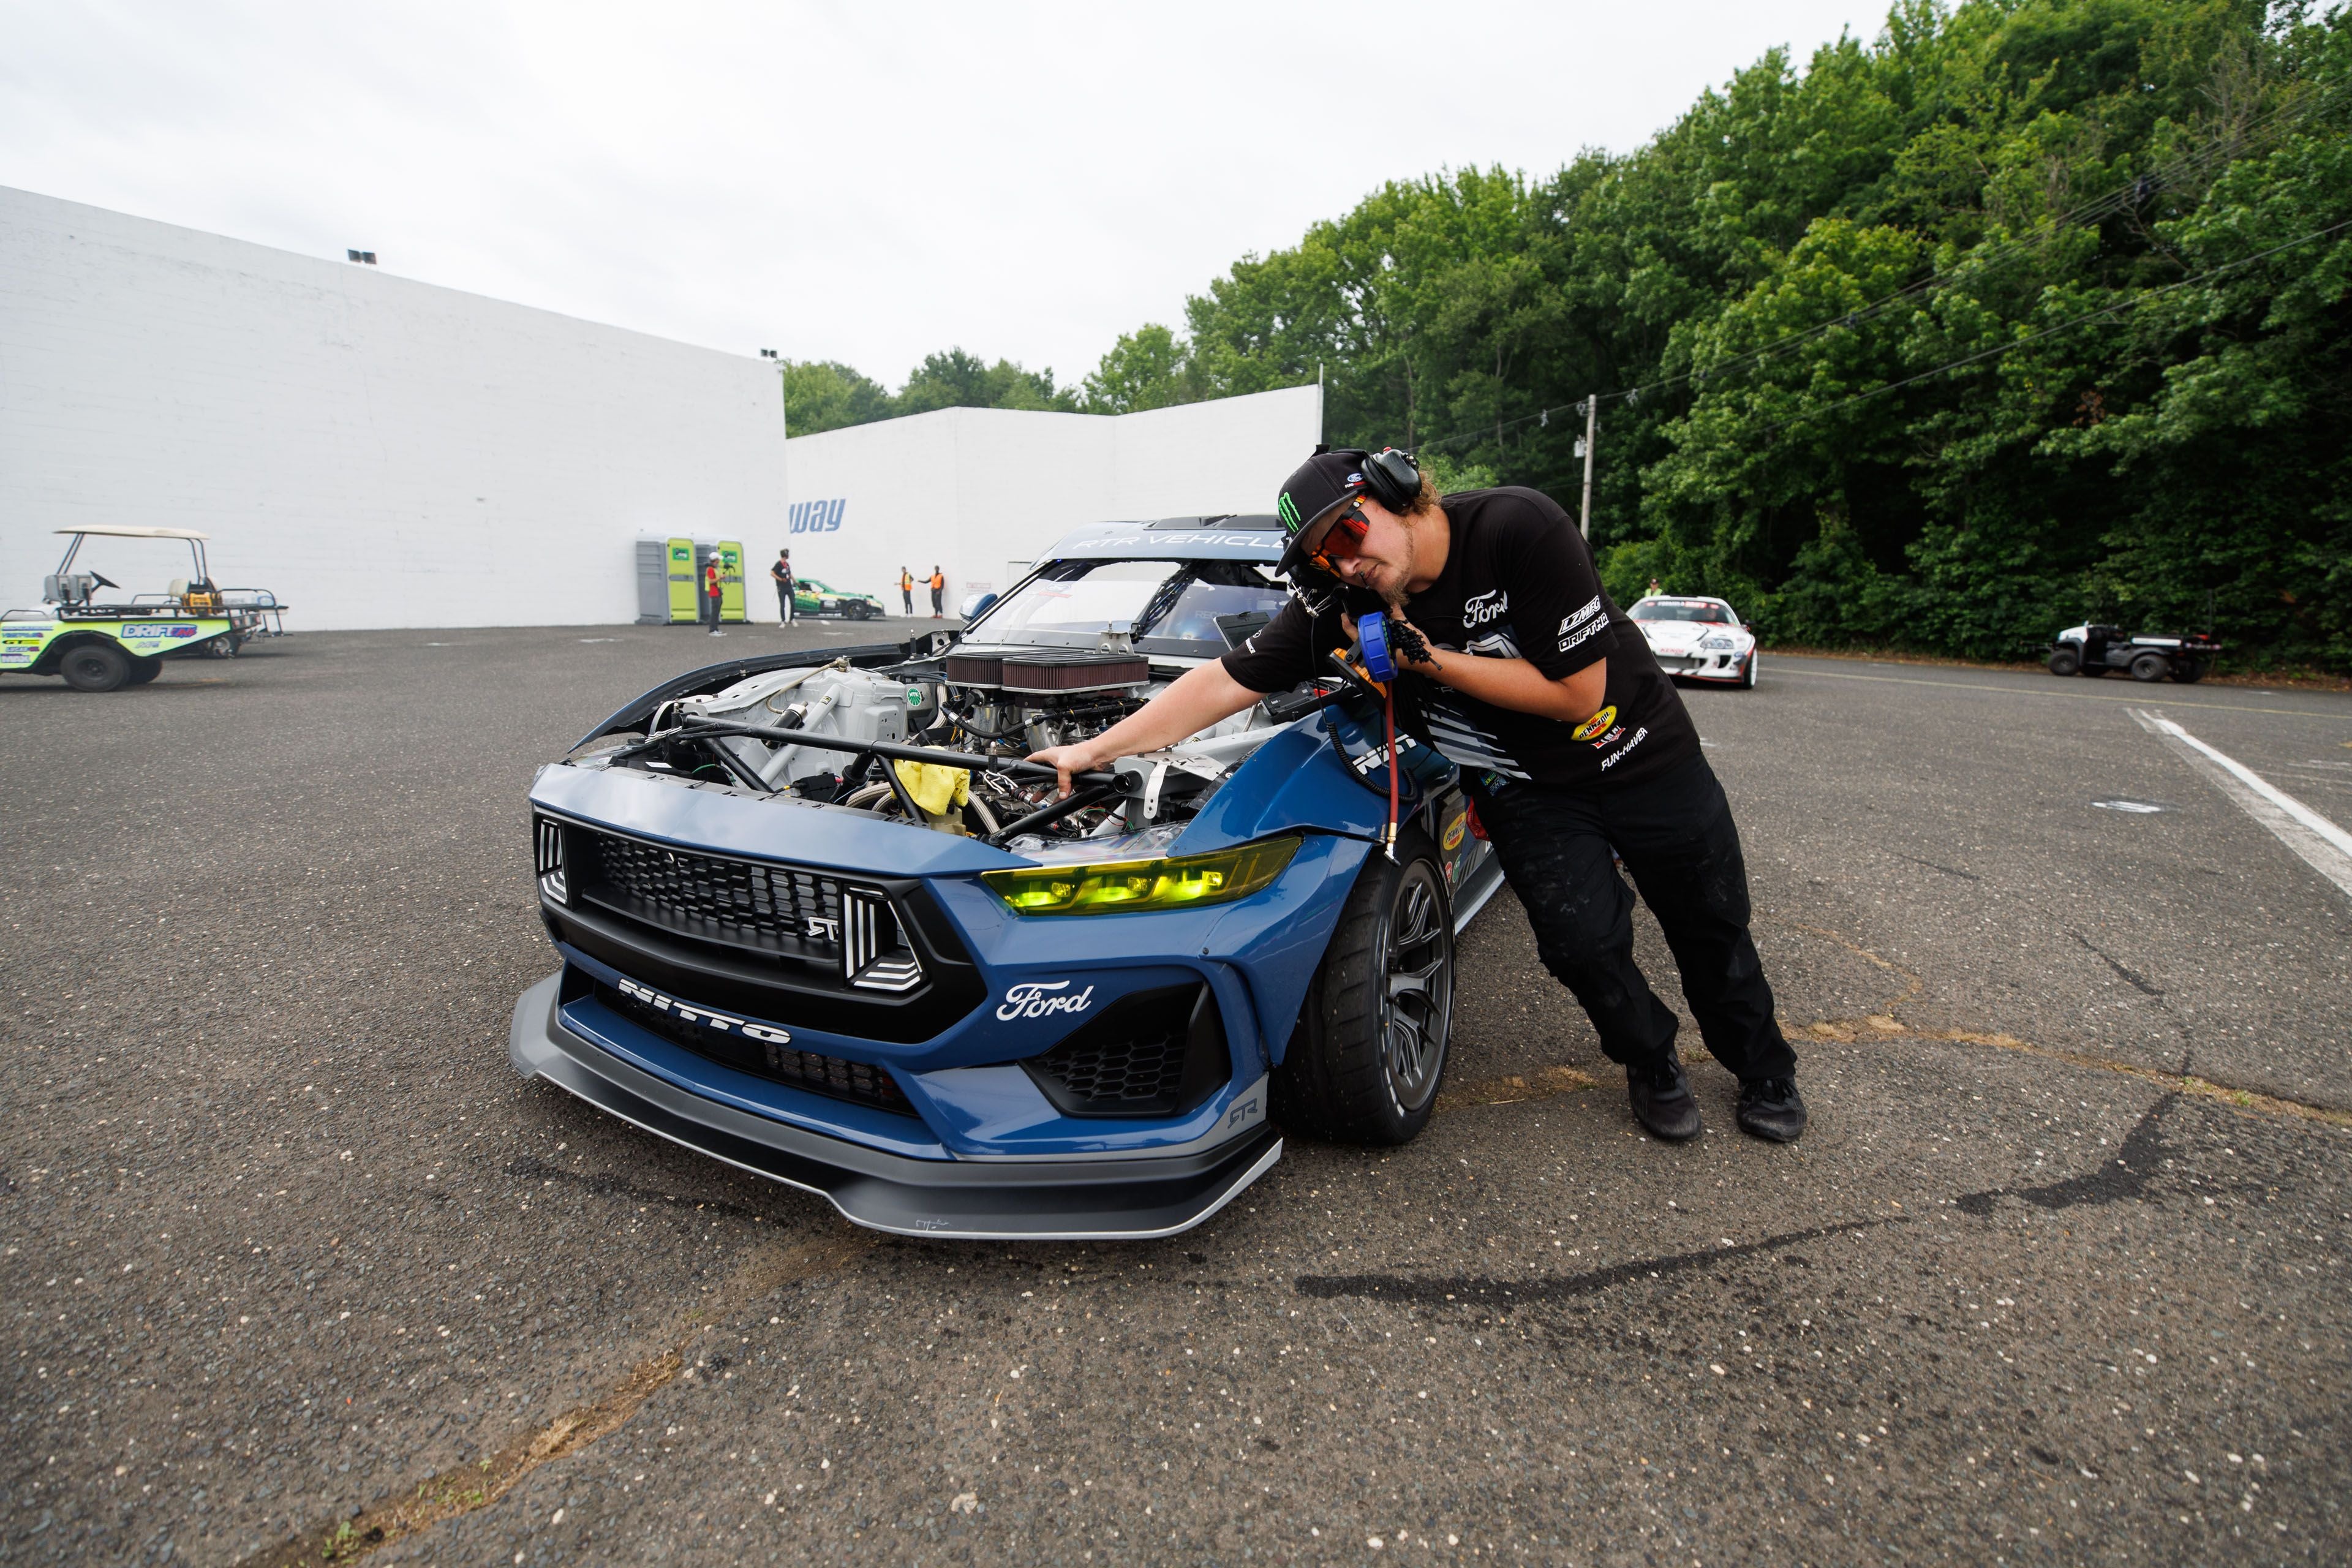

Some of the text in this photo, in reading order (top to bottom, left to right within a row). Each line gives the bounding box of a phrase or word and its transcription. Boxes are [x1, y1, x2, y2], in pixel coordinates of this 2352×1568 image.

[1073, 537, 1140, 549] RTR
[1463, 589, 1508, 628] Ford
[1558, 595, 1601, 636] LZMFG
[121, 624, 174, 638] DRIFT
[1558, 612, 1610, 652] DRIFTHQ
[1578, 711, 1611, 739] PENNZOIL
[1601, 727, 1648, 772] FUN-HAVER
[618, 978, 791, 1044] NITTO
[996, 980, 1094, 1021] Ford
